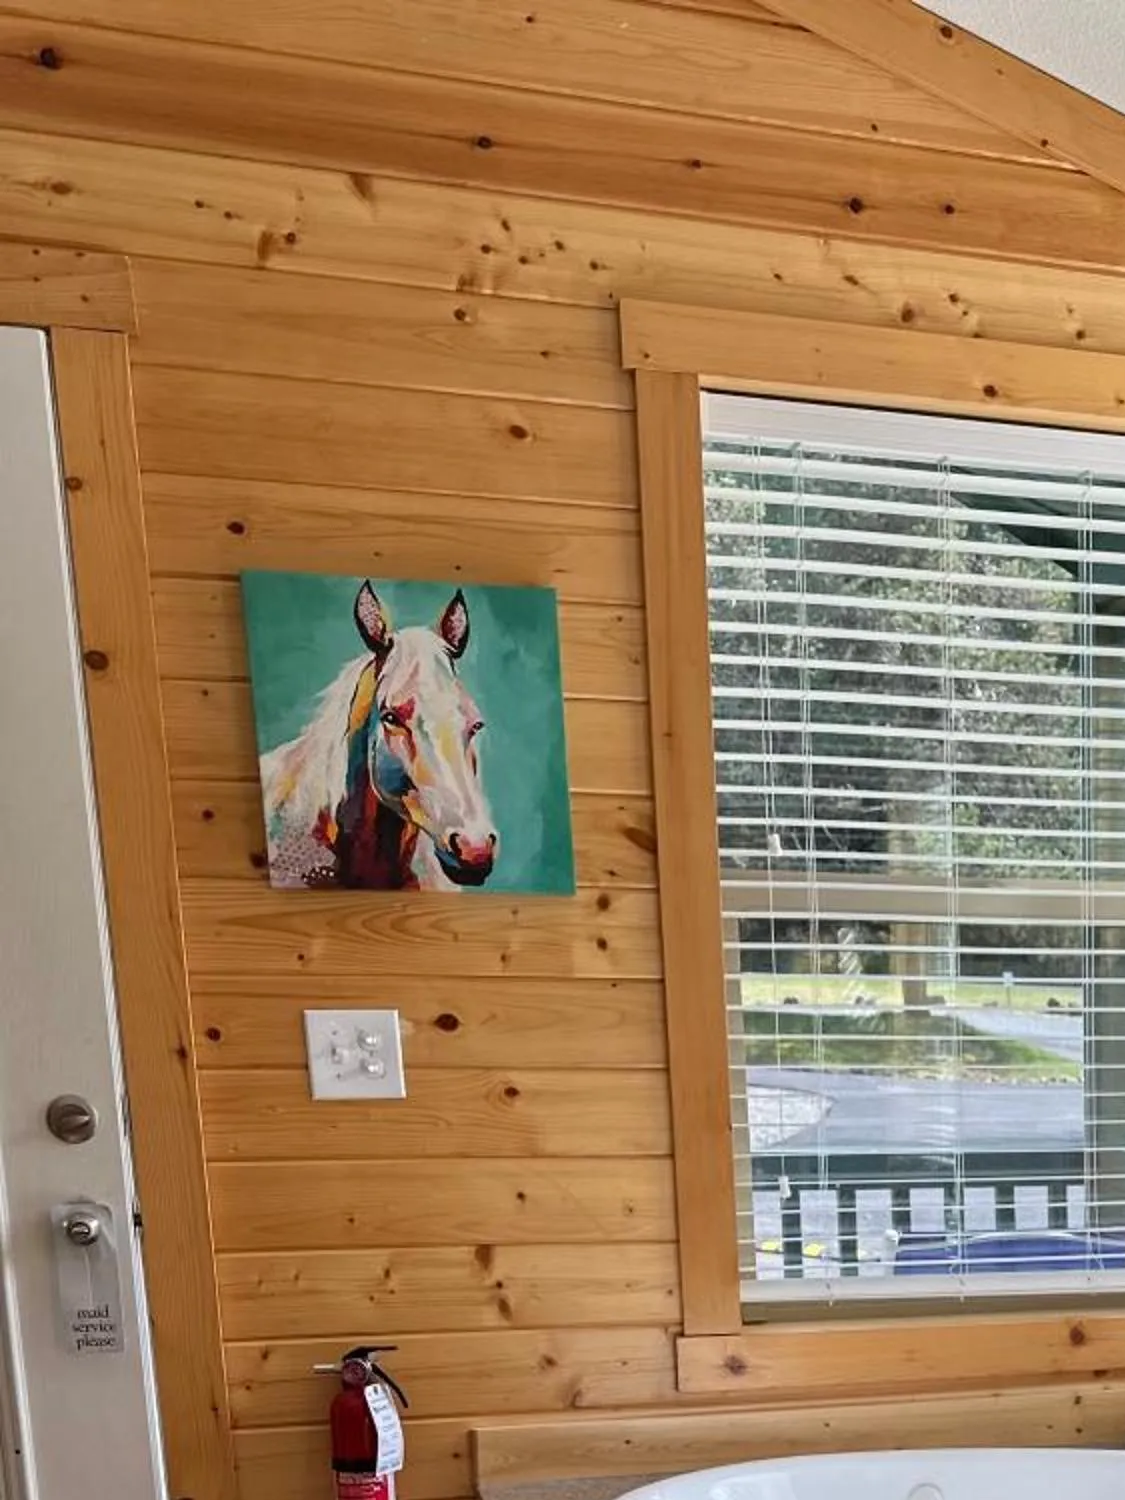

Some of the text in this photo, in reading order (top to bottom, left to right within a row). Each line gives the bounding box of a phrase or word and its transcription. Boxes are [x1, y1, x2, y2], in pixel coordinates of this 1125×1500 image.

[77, 1303, 109, 1319] maid
[72, 1322, 115, 1333] service
[76, 1334, 115, 1351] please
